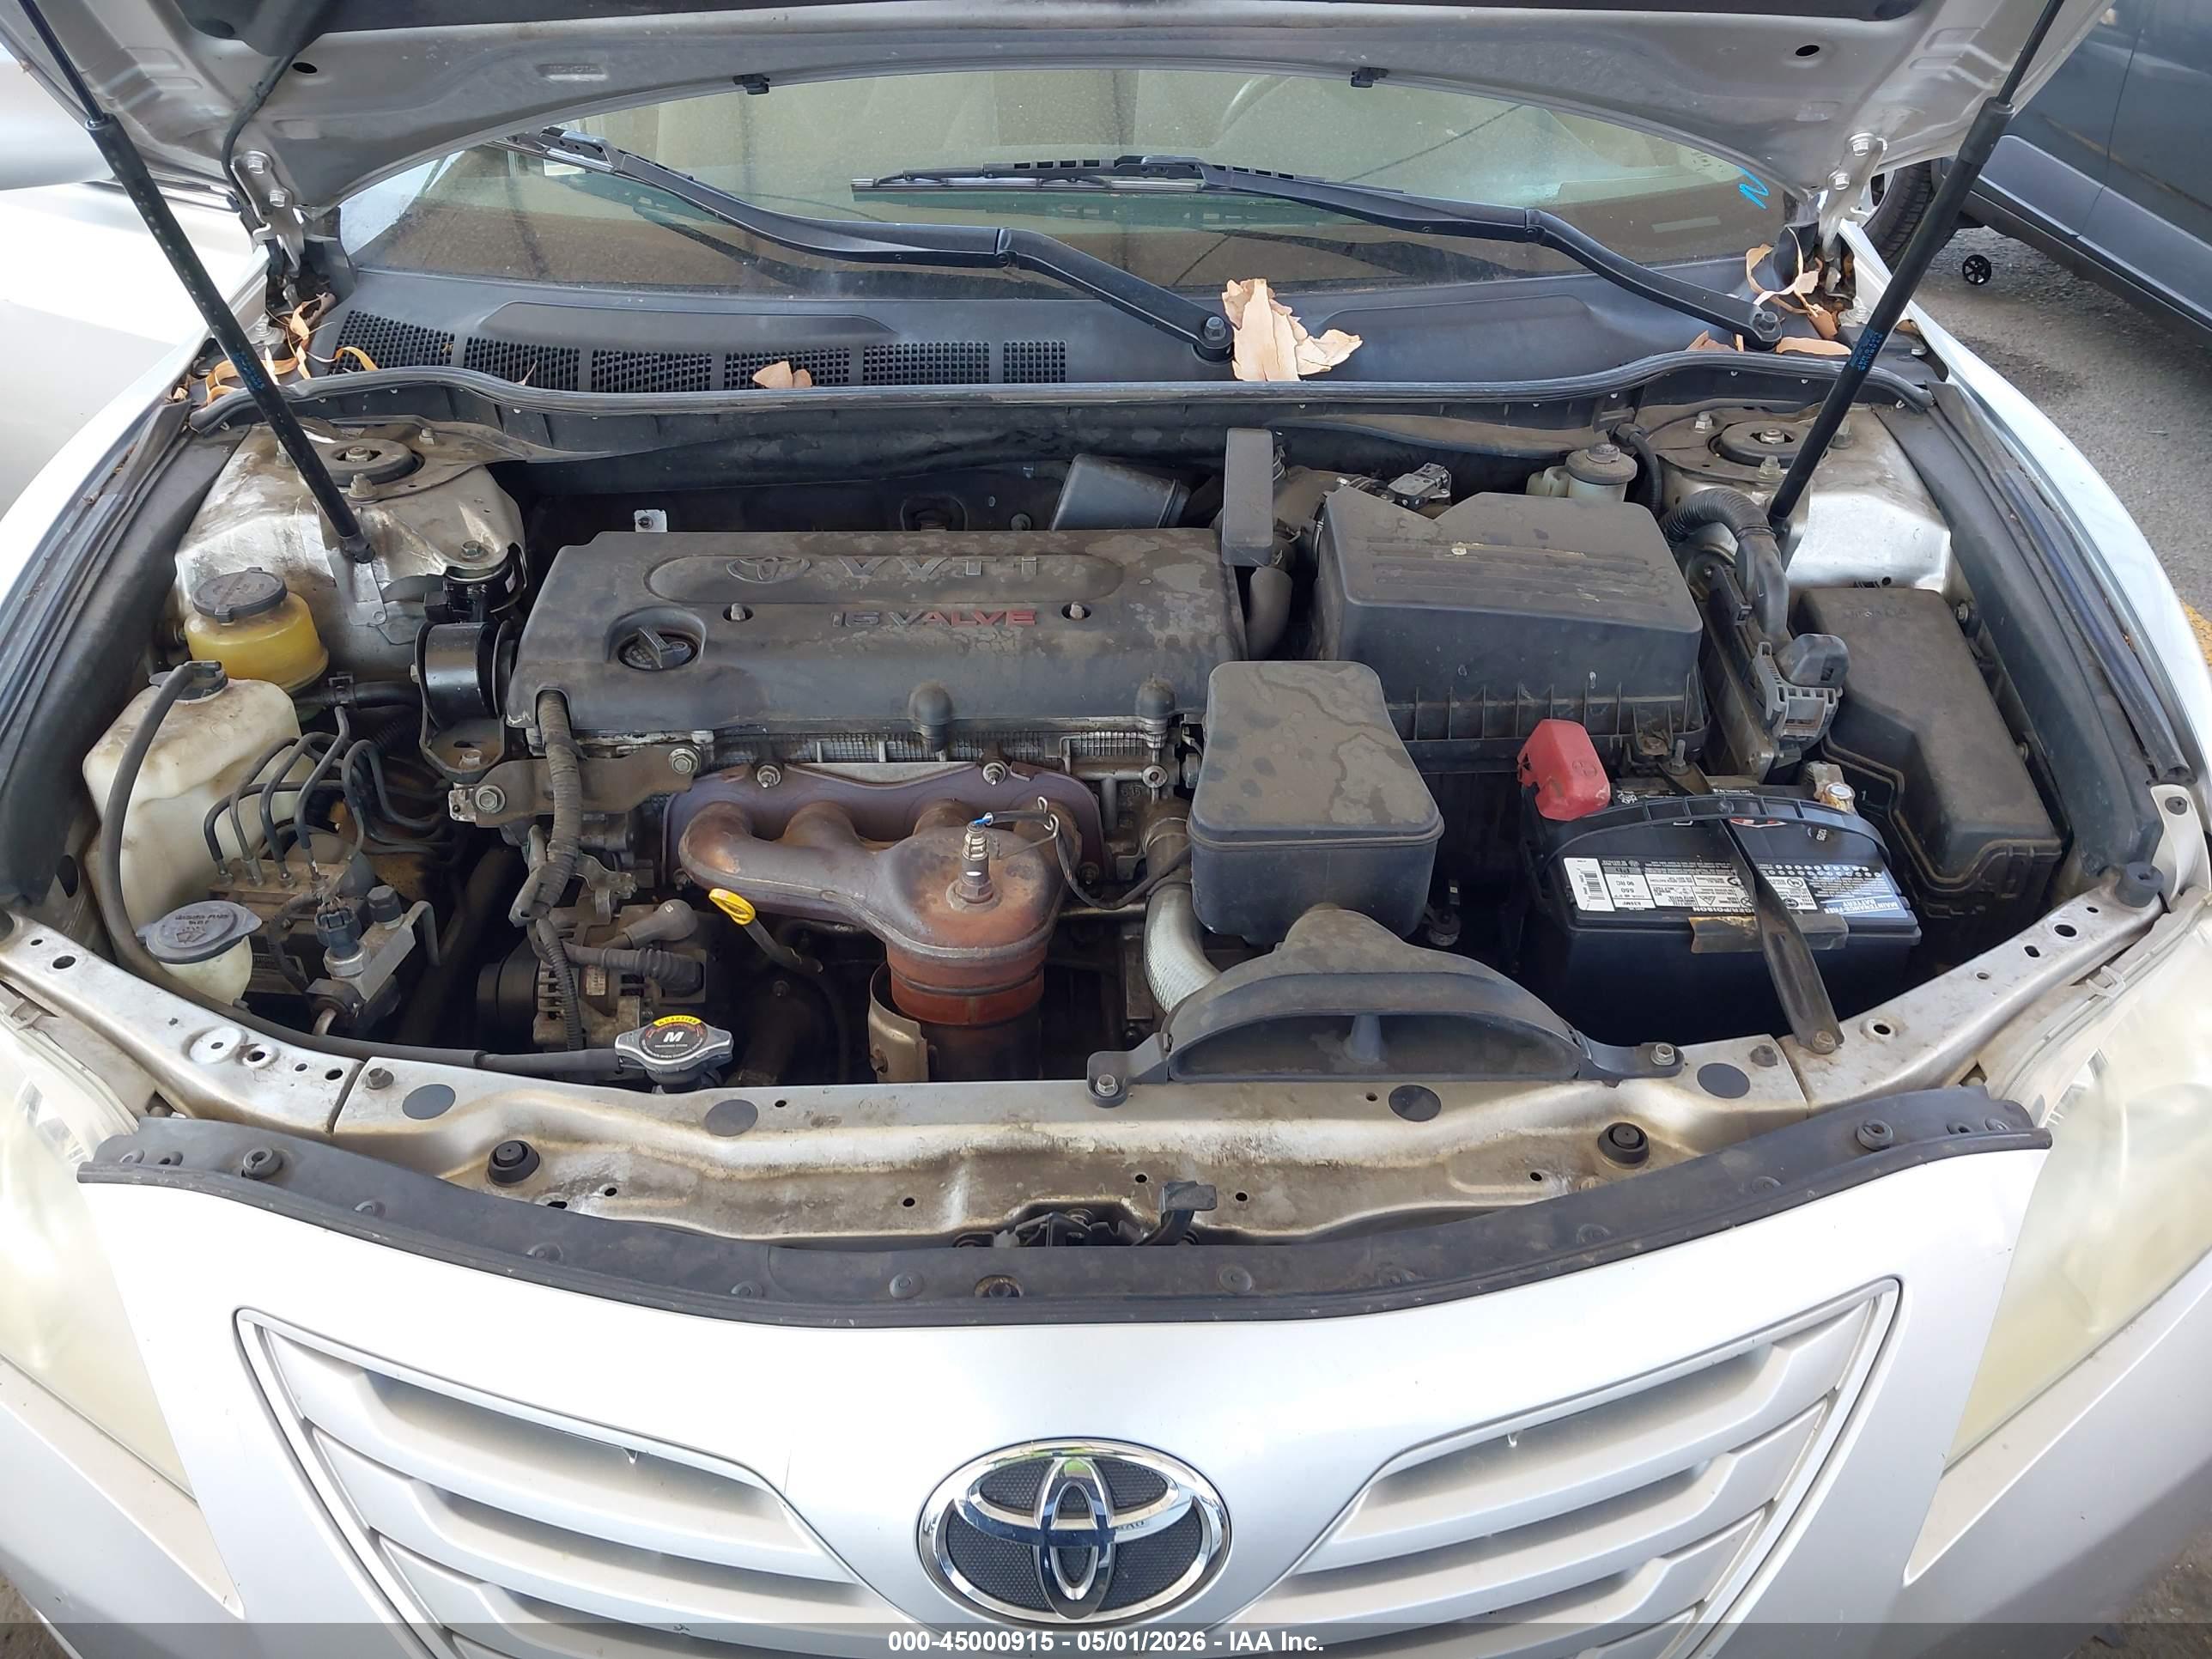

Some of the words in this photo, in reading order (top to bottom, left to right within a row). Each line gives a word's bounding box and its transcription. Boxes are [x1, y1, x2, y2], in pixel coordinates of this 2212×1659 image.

[831, 611, 880, 628] 16
[887, 610, 1036, 627] VALVE
[663, 1031, 684, 1042] M
